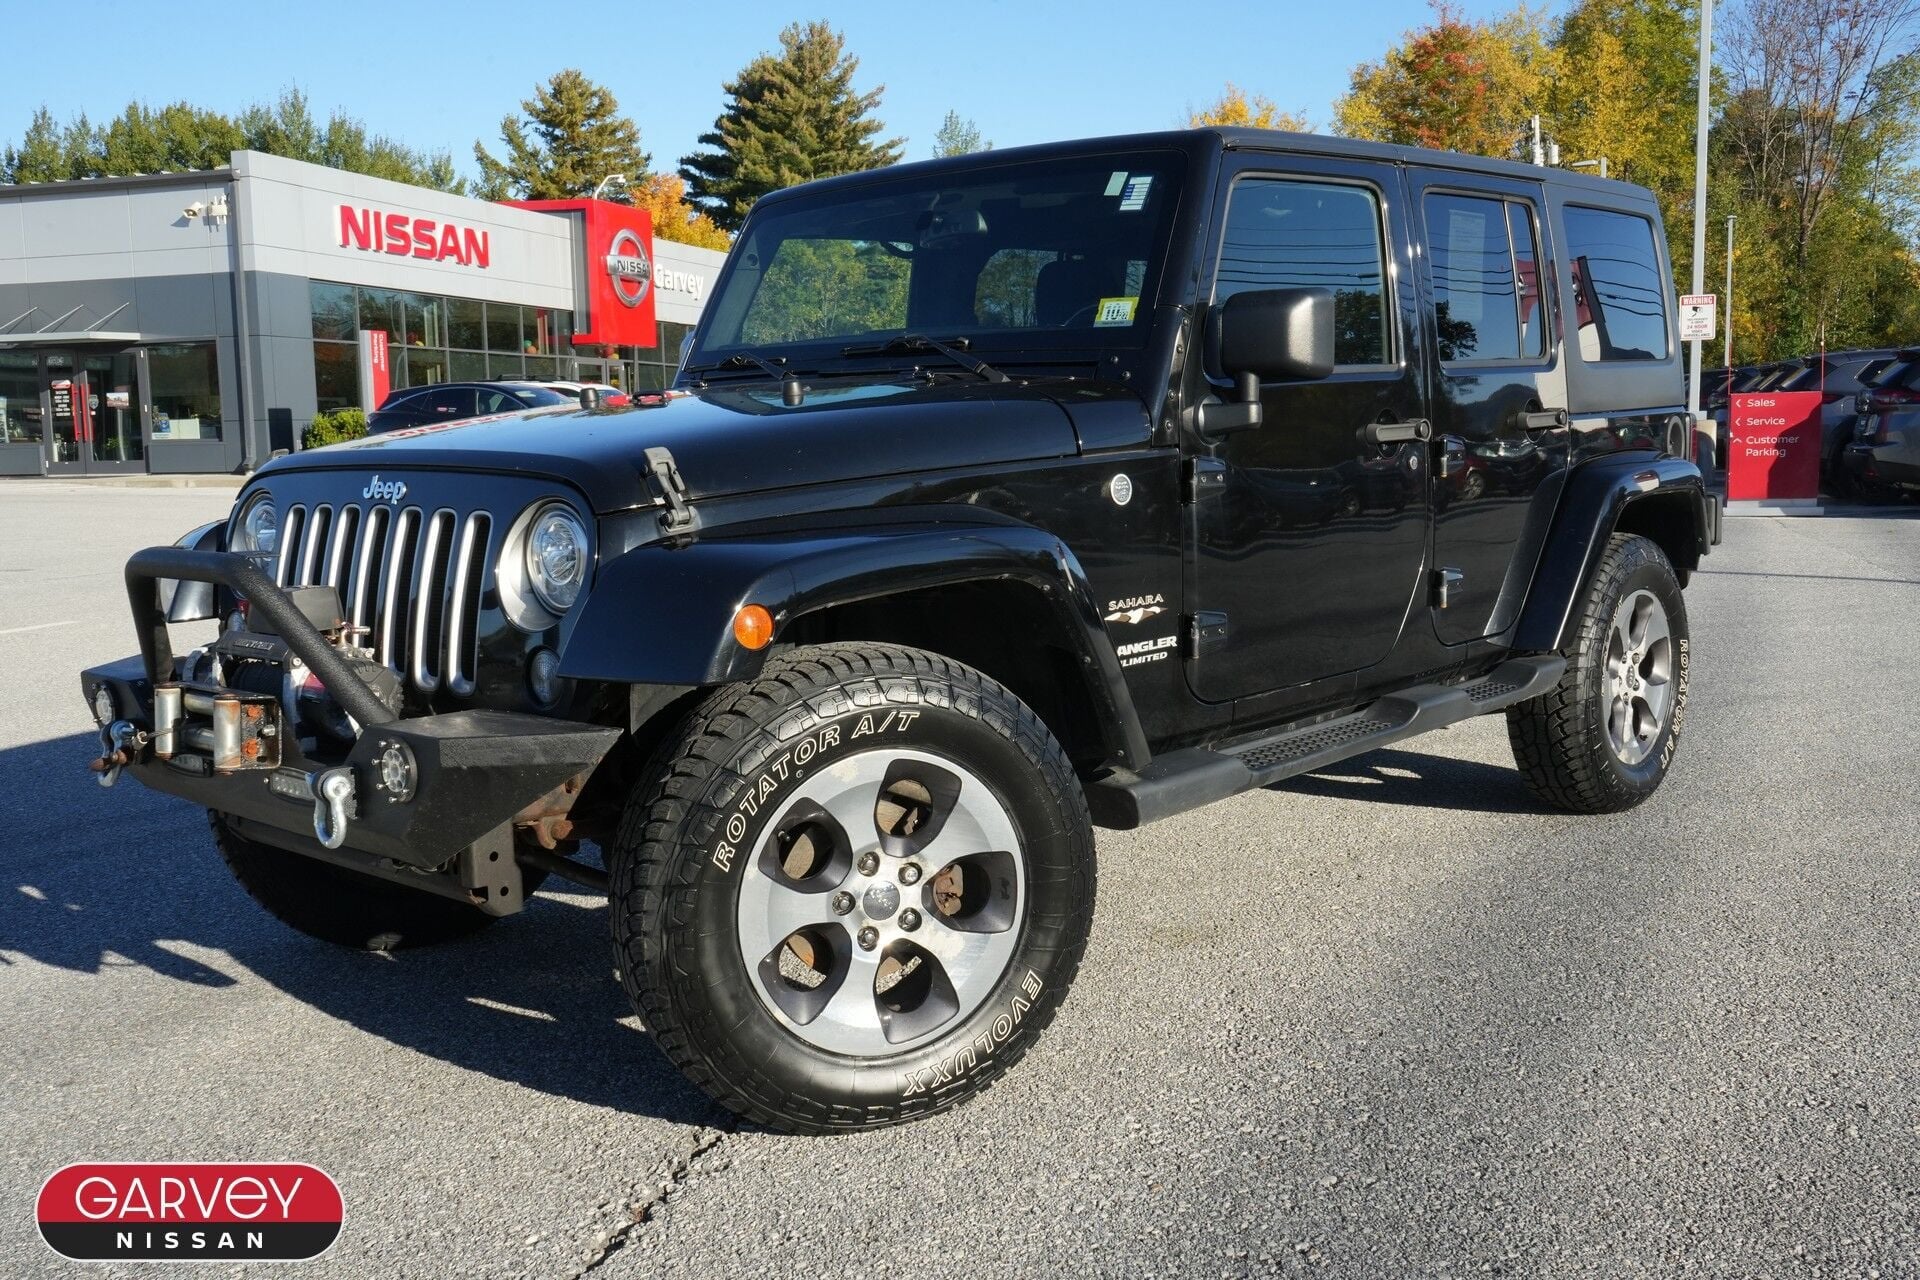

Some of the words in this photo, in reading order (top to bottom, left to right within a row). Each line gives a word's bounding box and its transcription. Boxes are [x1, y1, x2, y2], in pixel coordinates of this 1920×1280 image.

[338, 204, 490, 268] NISSAN
[655, 263, 704, 300] Garvey
[1683, 296, 1712, 305] WARNING
[1746, 398, 1776, 407] Sales
[1746, 416, 1786, 426] Service
[1745, 435, 1800, 444] Customer
[1745, 447, 1787, 458] Parking
[363, 474, 407, 505] Jeep
[1108, 593, 1164, 611] SAHARA
[1116, 635, 1178, 657] ANGLER
[1120, 651, 1168, 668] LIMITED
[1671, 638, 1689, 736] ROTATOR
[712, 724, 841, 873] ROTATOR
[850, 710, 920, 739] A/T
[902, 968, 1044, 1097] EVOLUXX
